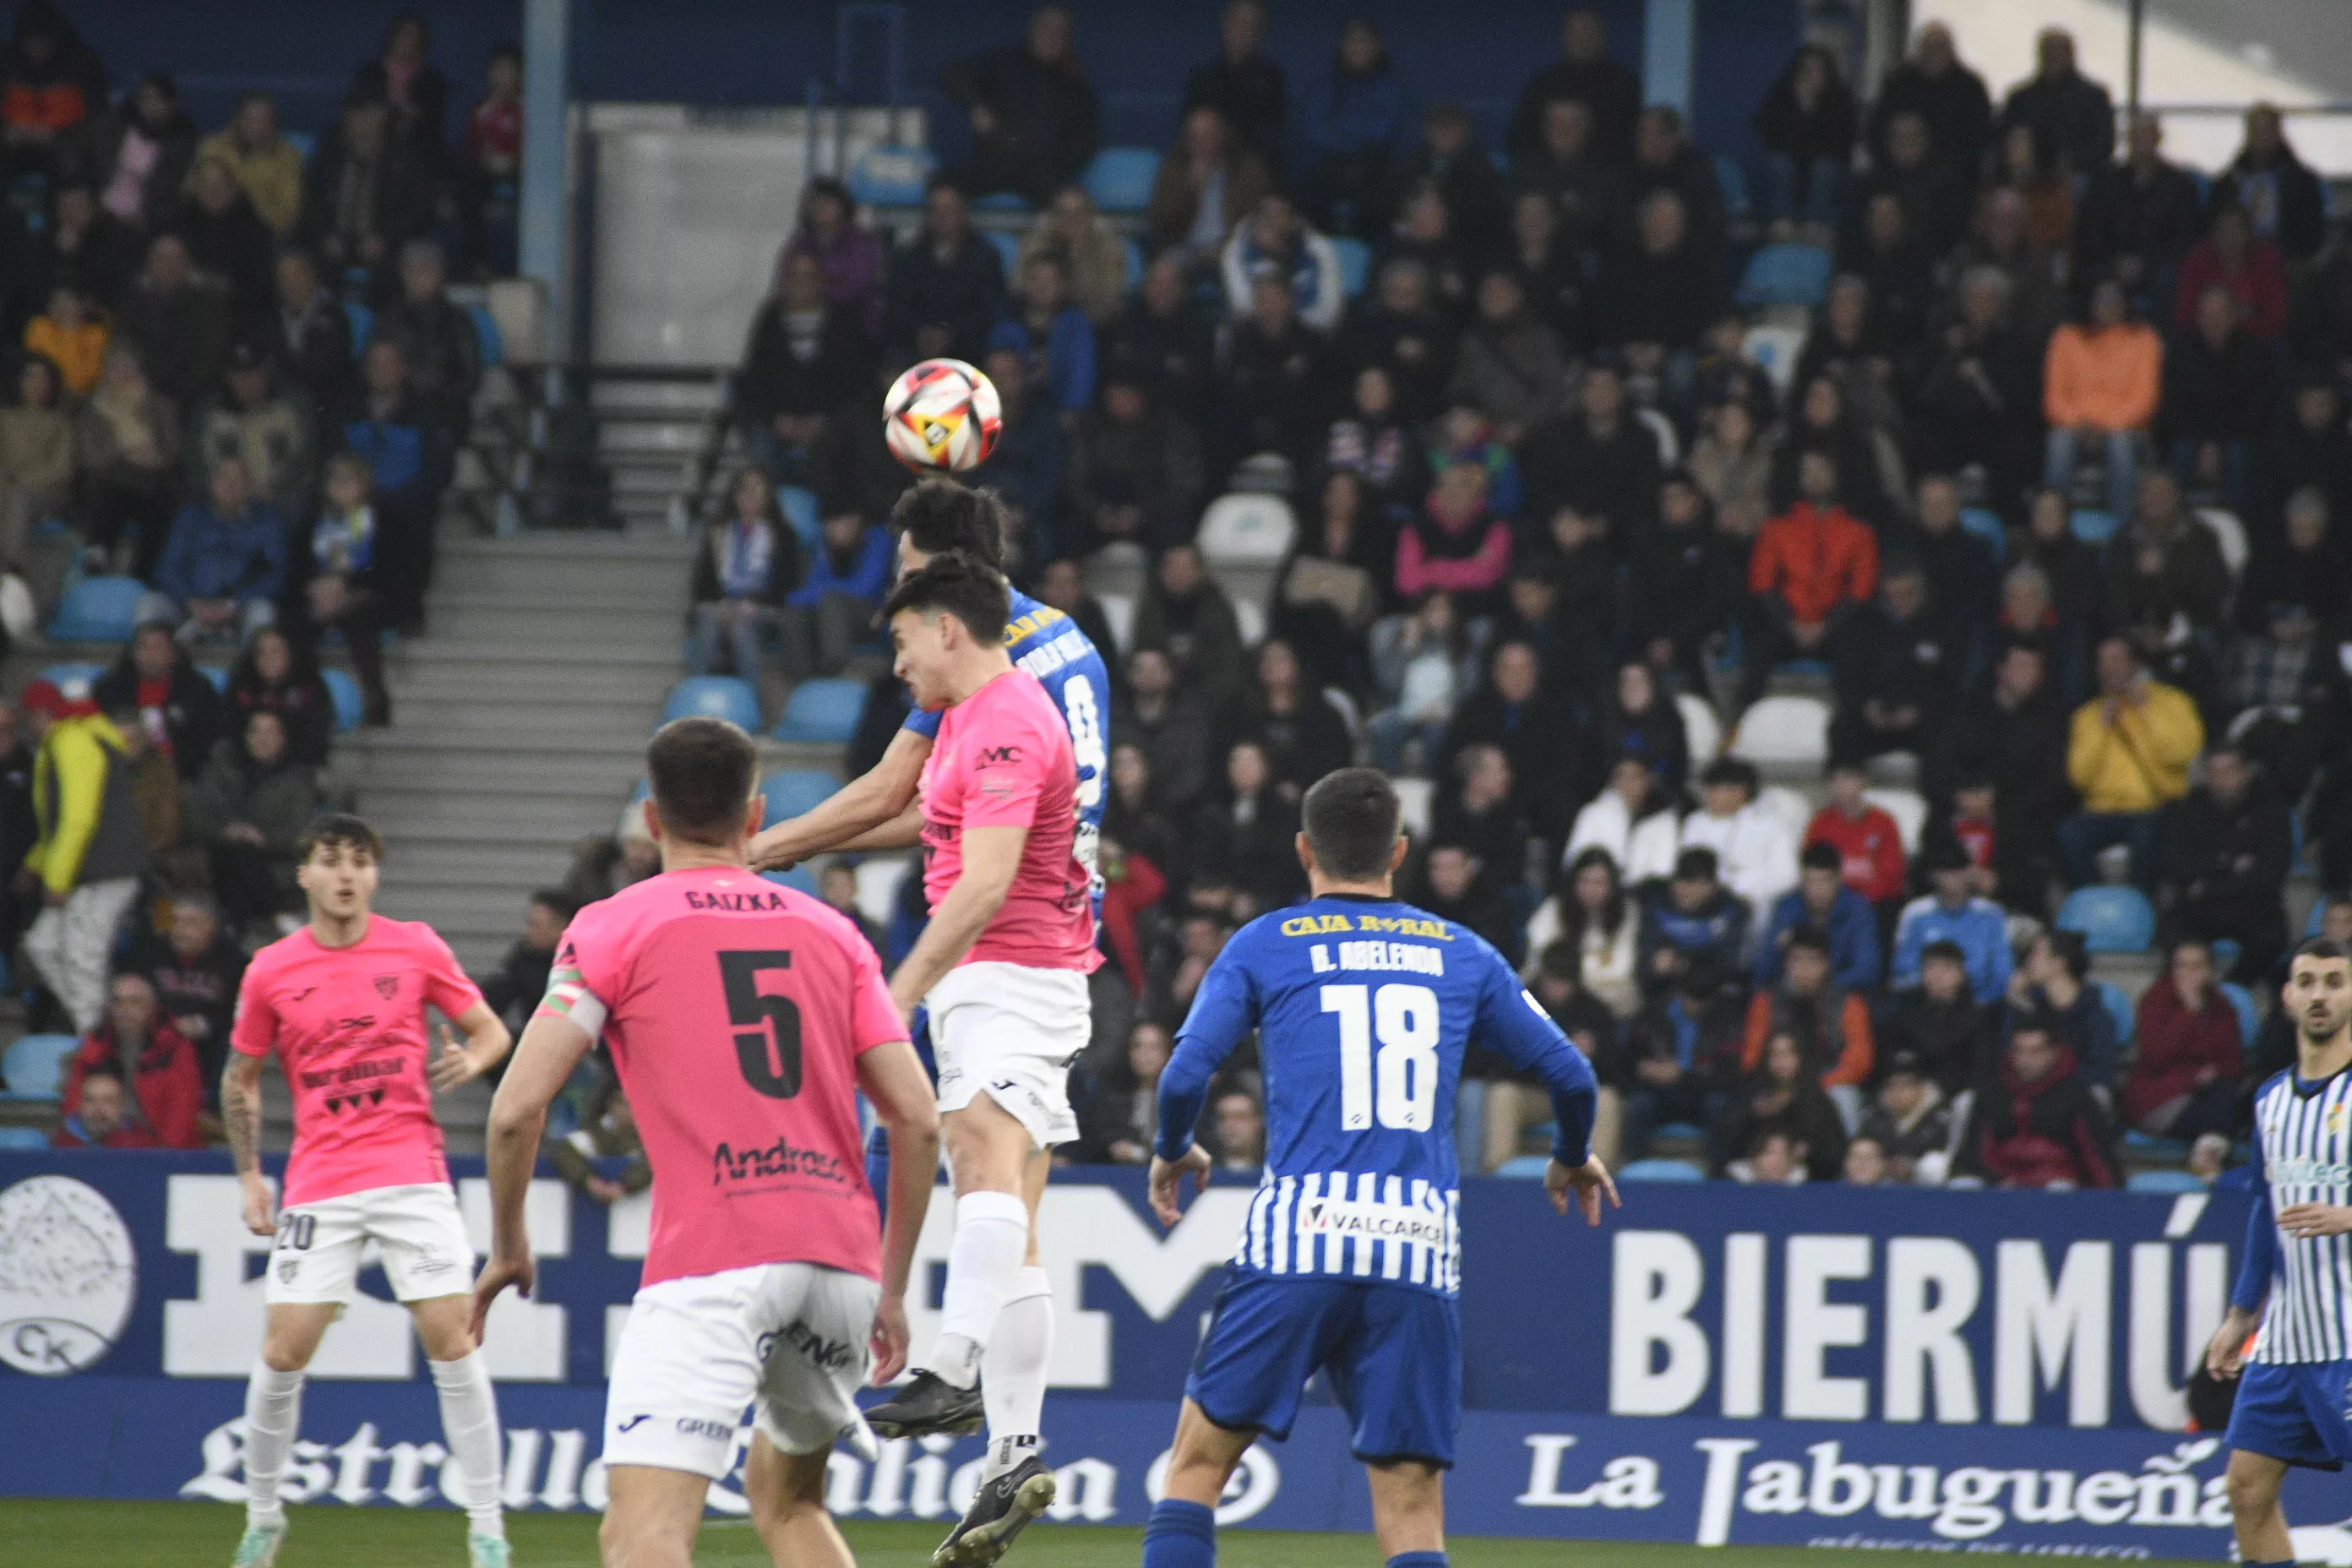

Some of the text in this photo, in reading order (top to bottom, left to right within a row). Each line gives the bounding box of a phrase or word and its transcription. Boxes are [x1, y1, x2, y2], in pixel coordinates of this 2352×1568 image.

[684, 891, 788, 912] GAIZKA
[1281, 914, 1354, 936] CAJA
[1310, 944, 1337, 973] B.
[717, 950, 803, 1100] 5
[1320, 983, 1440, 1132] 18
[276, 1213, 317, 1250] 20
[1516, 1434, 1664, 1509] La
